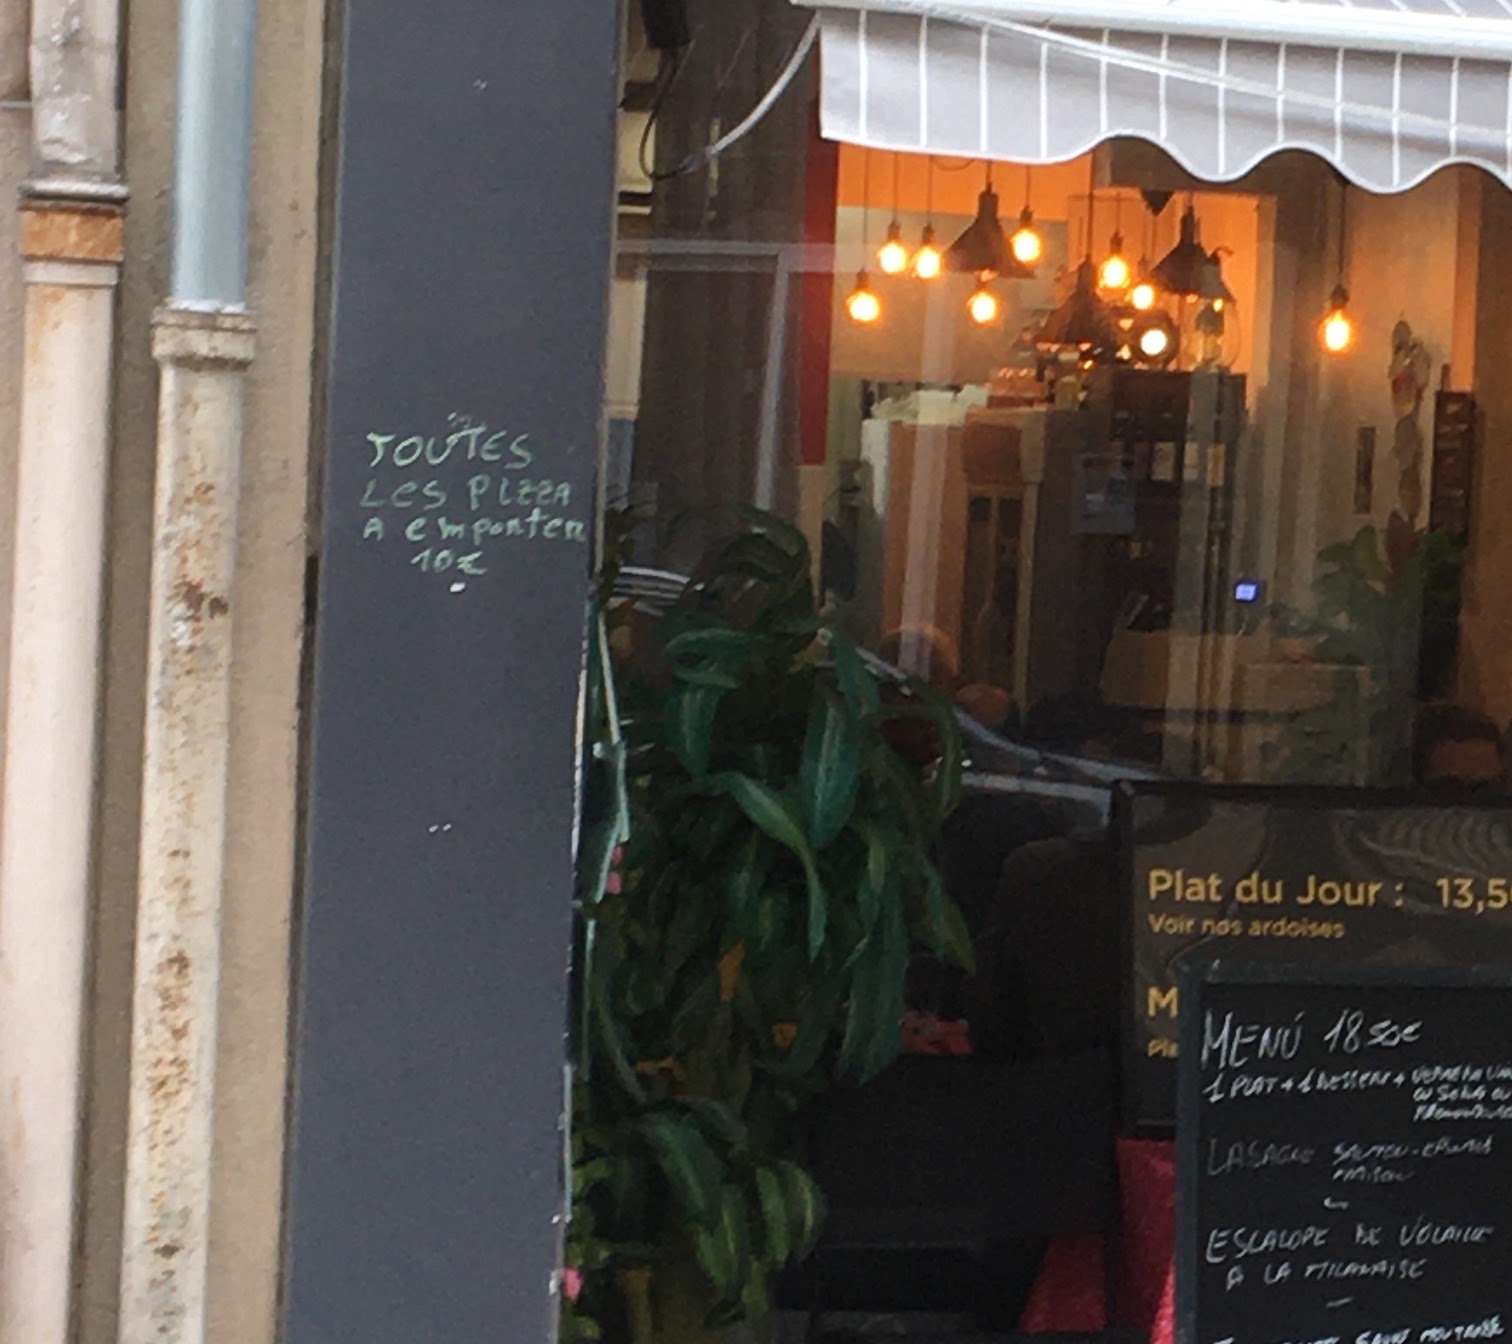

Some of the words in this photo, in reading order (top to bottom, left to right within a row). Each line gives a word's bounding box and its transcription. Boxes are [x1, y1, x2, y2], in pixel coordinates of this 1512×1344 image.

[367, 424, 533, 470] TOUTES
[363, 516, 384, 541] A
[410, 548, 488, 576] 10€
[1148, 868, 1221, 903] Plat
[1236, 872, 1284, 905] du
[1295, 875, 1383, 907] Jour
[1148, 914, 1196, 936] Voir
[1202, 920, 1242, 936] nos
[1250, 916, 1345, 939] ardoises
[1230, 1071, 1278, 1099] PLAT
[1206, 1224, 1331, 1264] ESCALOPE
[1263, 1262, 1293, 1285] LA
